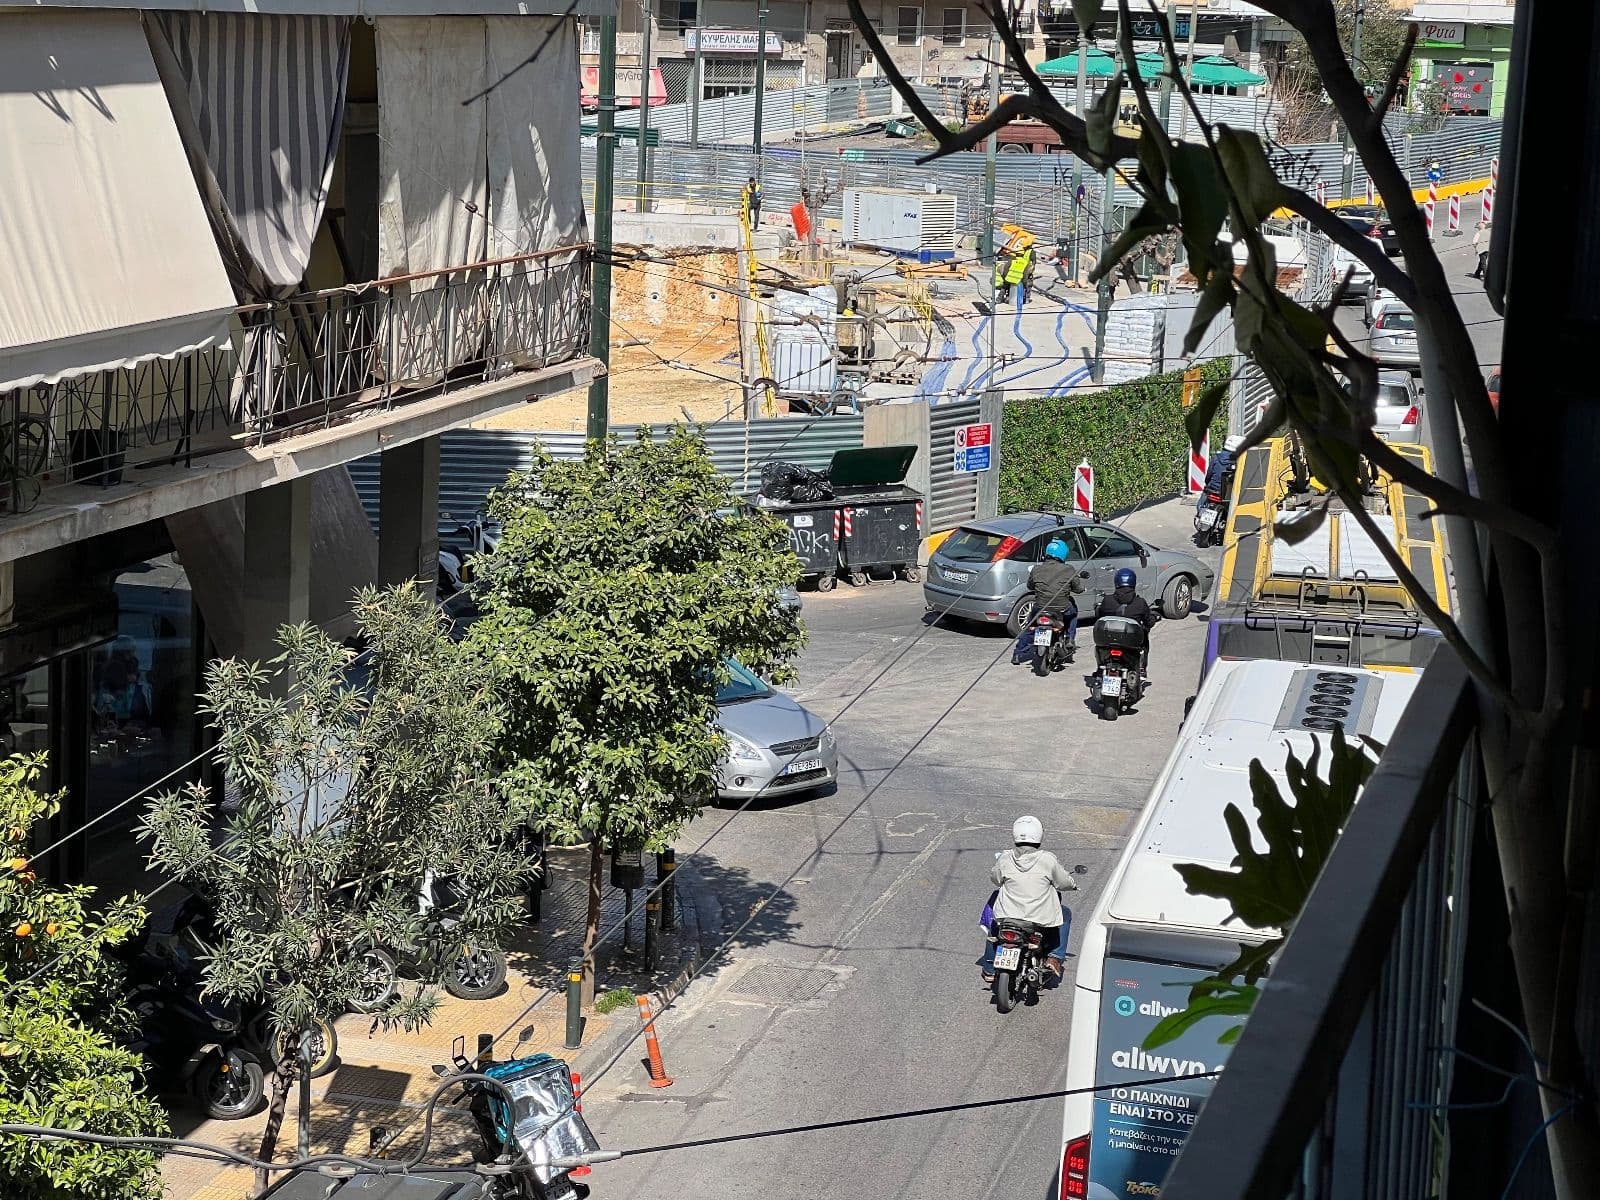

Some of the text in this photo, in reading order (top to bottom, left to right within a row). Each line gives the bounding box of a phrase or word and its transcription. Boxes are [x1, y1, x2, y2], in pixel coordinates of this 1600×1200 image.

[701, 34, 776, 45] ΚΥΨΕΛΗΣ MARET
[1425, 25, 1456, 39] Φυτά
[1111, 1087, 1190, 1109] ΤΟ ΠΑΙΧΝΙΔΙ
[1109, 1103, 1145, 1118] ΕΙΝΑΙ
[1147, 1108, 1174, 1122] ΣΤΟ
[1109, 1127, 1156, 1143] Κατεβάζεις
